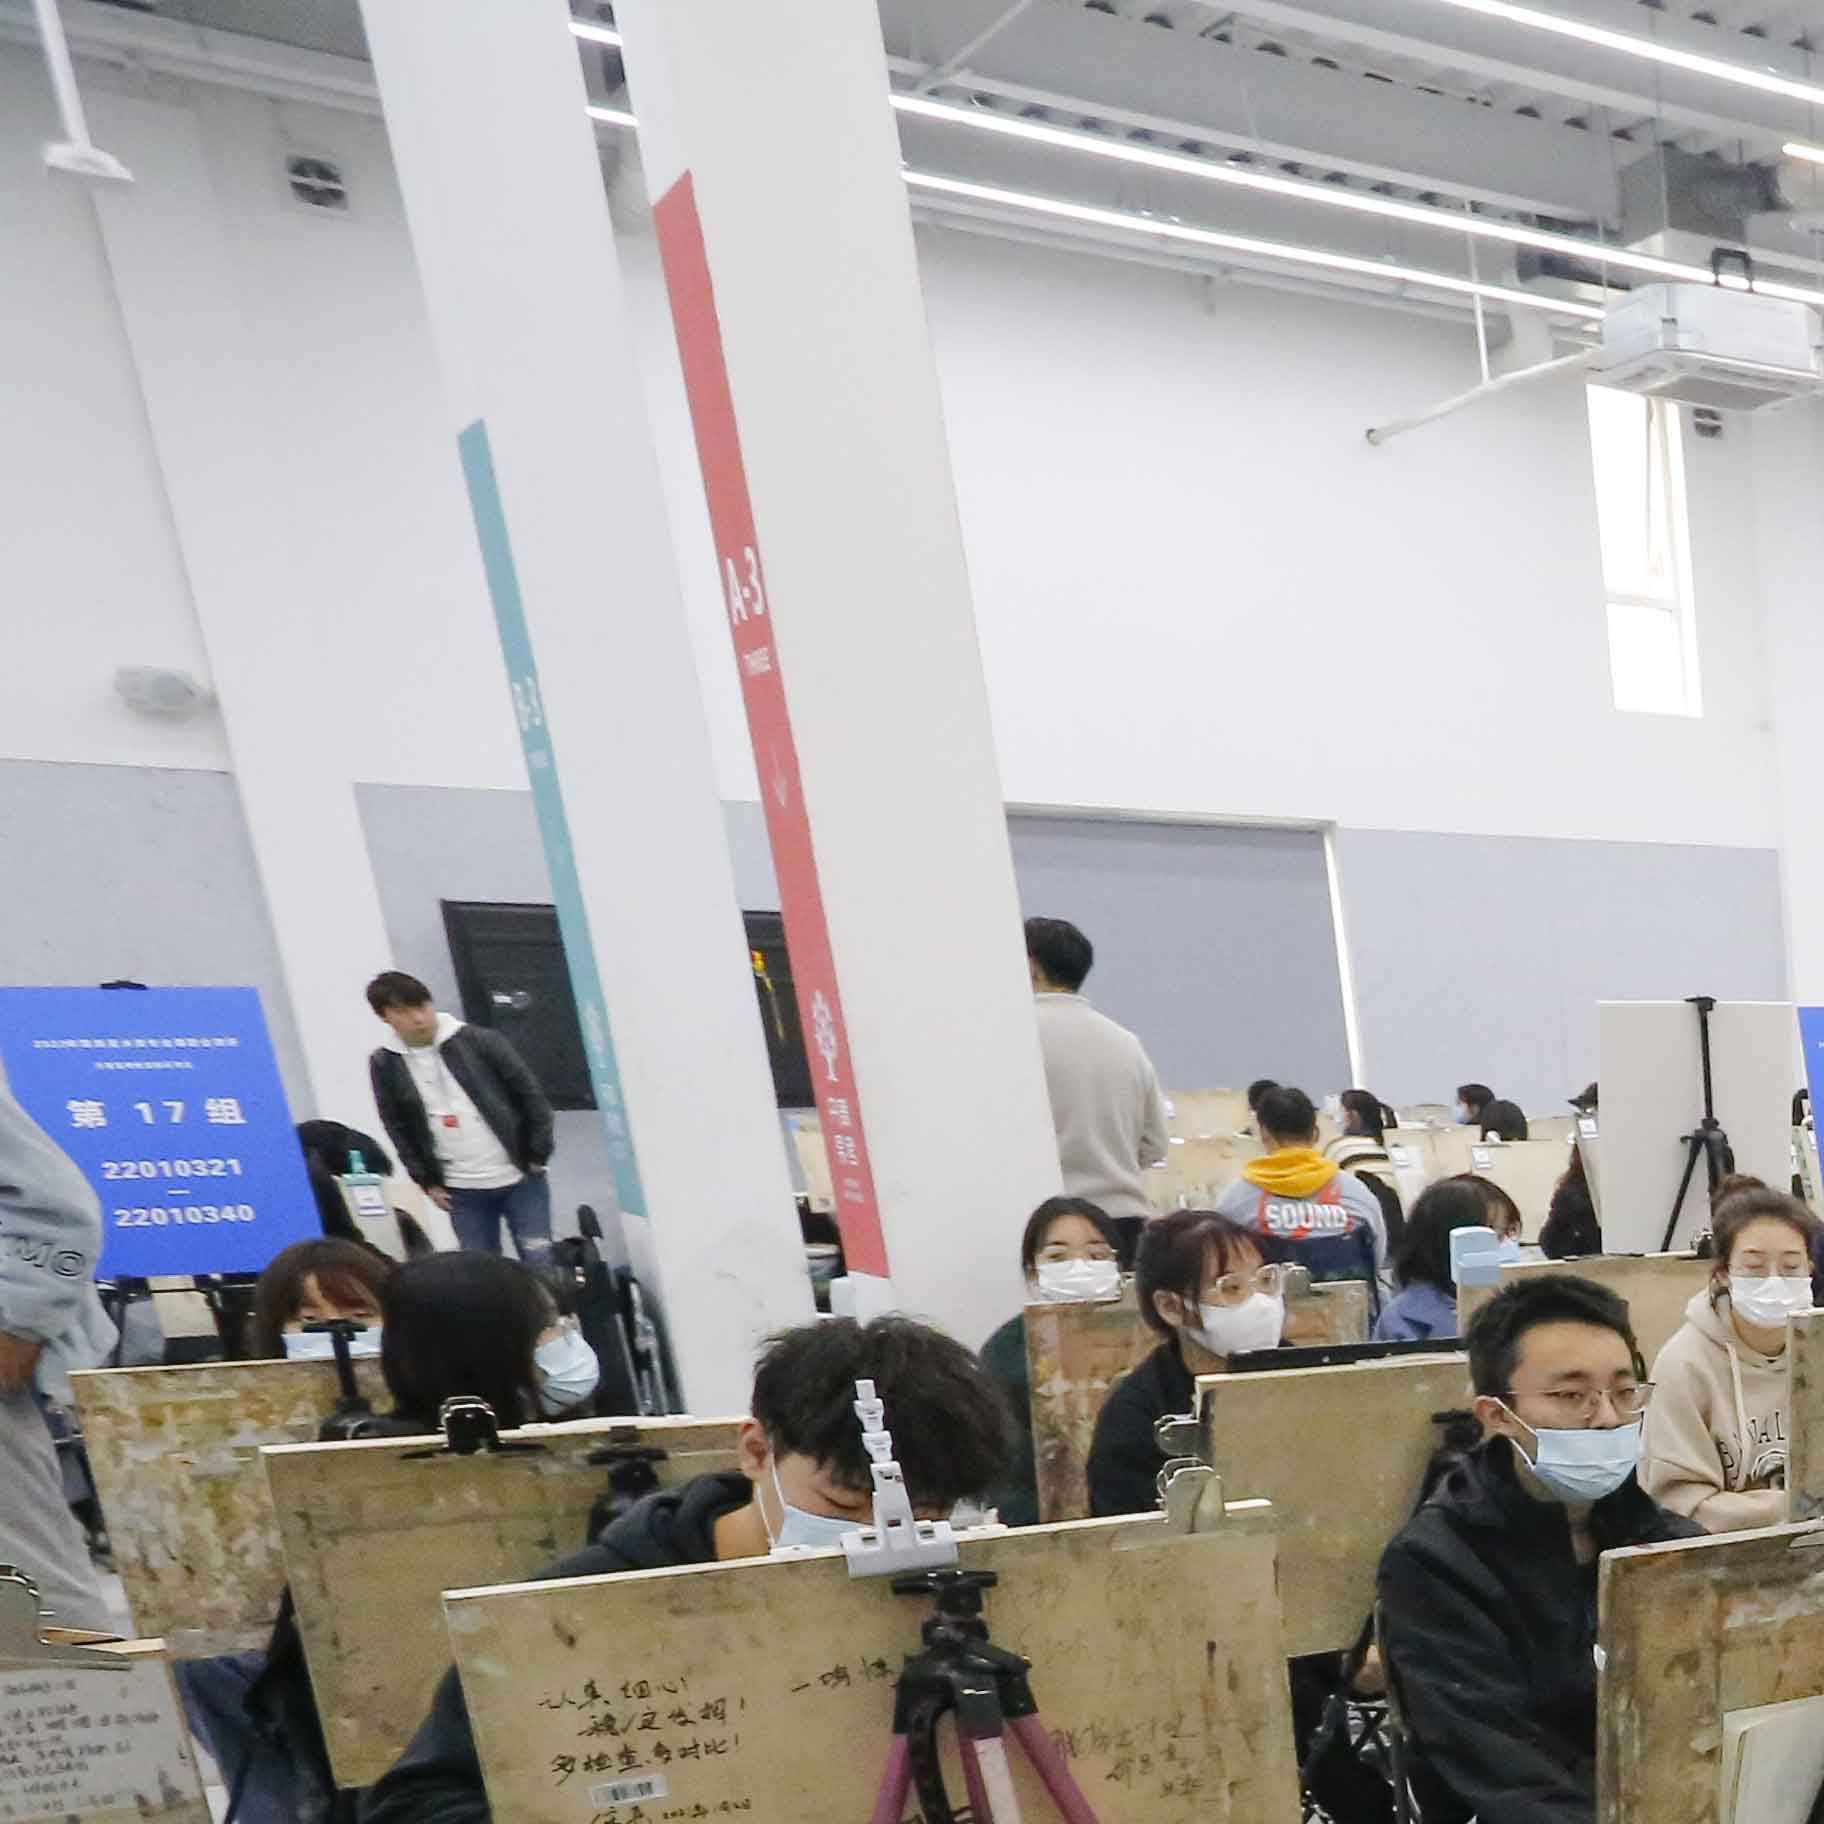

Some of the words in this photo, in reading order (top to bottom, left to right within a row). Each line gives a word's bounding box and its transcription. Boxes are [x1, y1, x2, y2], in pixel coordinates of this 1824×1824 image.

[726, 546, 766, 624] A-3
[66, 1099, 108, 1129] 第
[134, 1101, 185, 1125] 17
[204, 1098, 248, 1125] 组
[101, 1159, 243, 1180] 22010321
[113, 1204, 255, 1228] 22010340
[1265, 1201, 1347, 1230] SOUND
